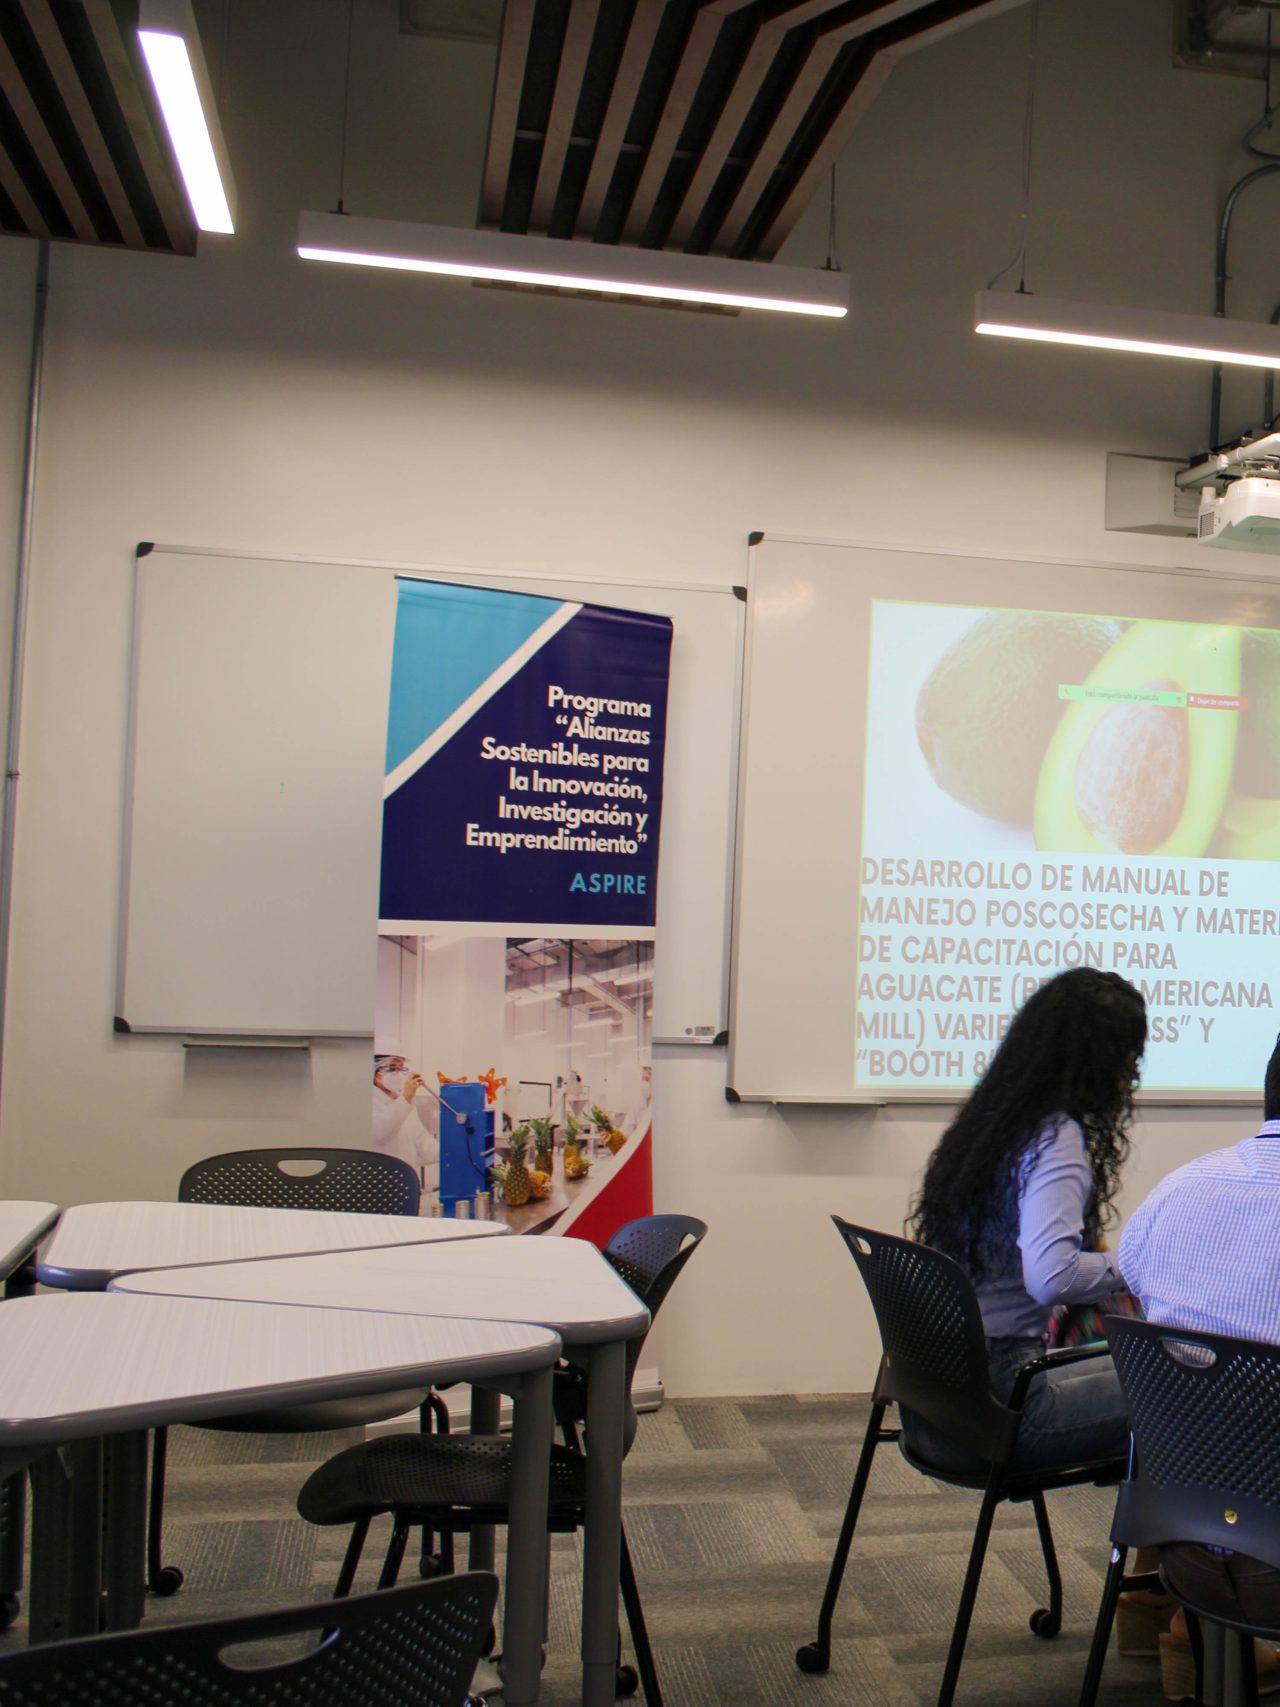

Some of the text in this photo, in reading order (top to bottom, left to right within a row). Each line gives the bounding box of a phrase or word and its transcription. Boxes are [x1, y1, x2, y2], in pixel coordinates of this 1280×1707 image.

[548, 685, 651, 718] Programa
[555, 714, 651, 745] “Alianzas
[480, 737, 650, 775] Sostenibles para
[509, 767, 648, 803] la Innovación,
[498, 796, 648, 833] Investigación y
[465, 823, 648, 854] Emprendimiento”
[569, 872, 647, 895] ASPIRE
[861, 857, 1230, 898] DESARROLLO DE MANUAL DE
[859, 895, 976, 927] MANEJO
[985, 899, 1165, 932] POSCOSECHA
[1172, 906, 1189, 933] Y
[858, 932, 1178, 970] DE CAPACITACIÓN PARA
[858, 973, 1002, 1003] AGUACATE
[1127, 979, 1273, 1009] MERICANA
[856, 1008, 925, 1049] MILL)
[1199, 1017, 1216, 1043] Y
[856, 1049, 964, 1078] “BOOTH
